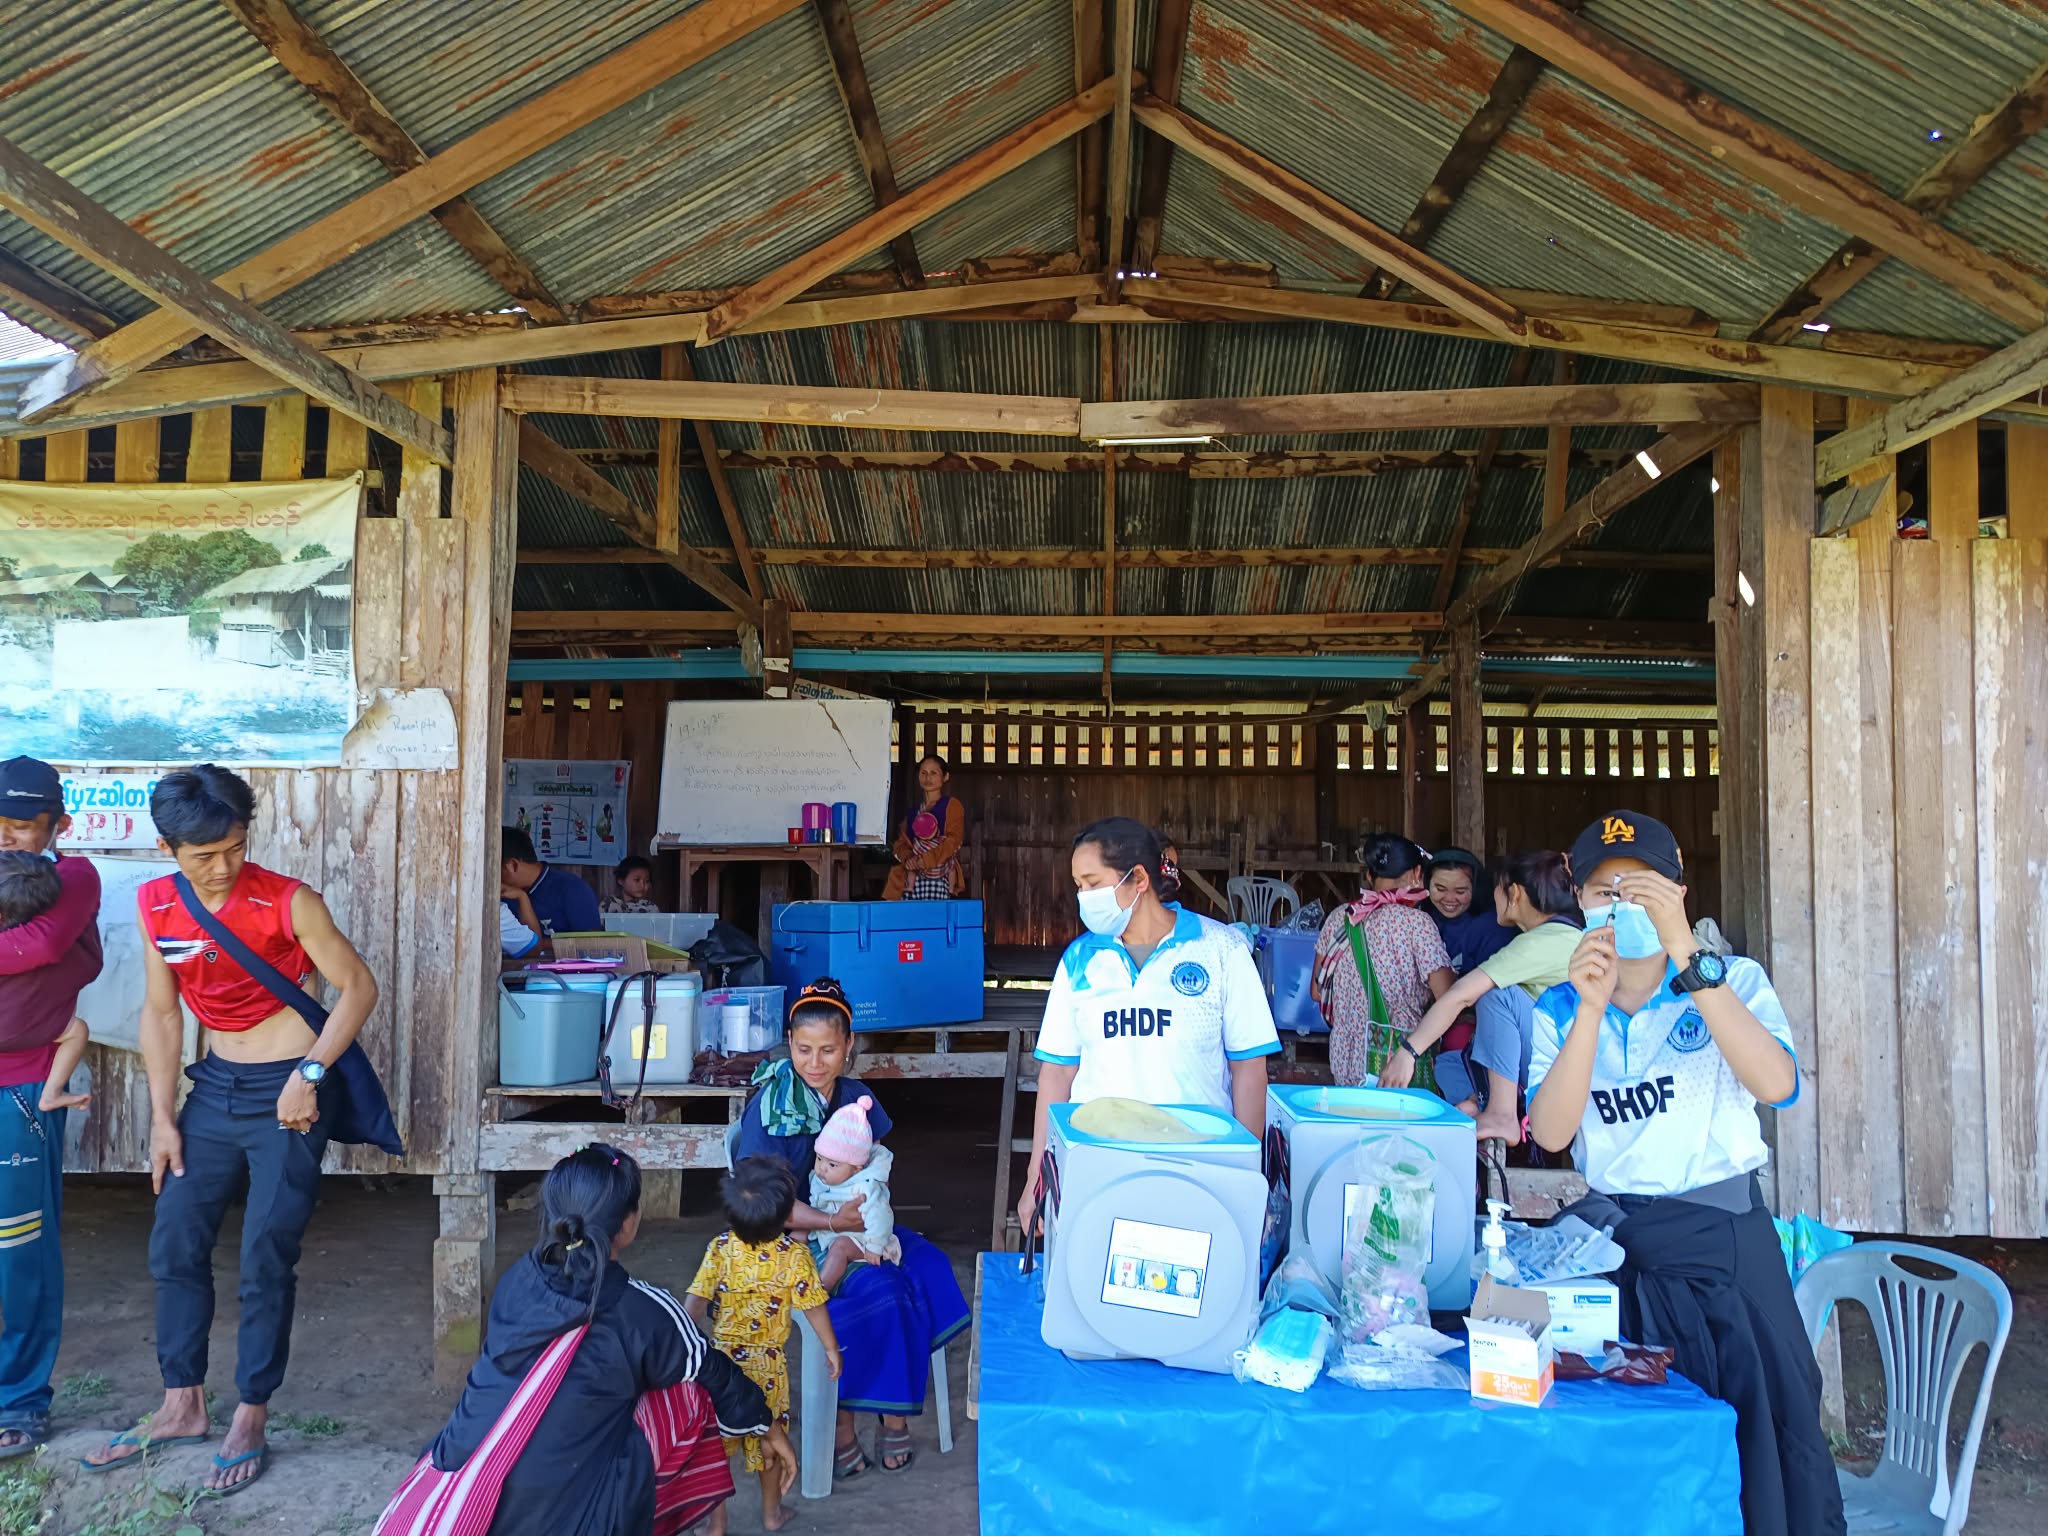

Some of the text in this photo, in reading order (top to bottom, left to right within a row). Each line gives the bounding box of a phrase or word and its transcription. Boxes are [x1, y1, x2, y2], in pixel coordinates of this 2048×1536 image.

[1601, 816, 1635, 845] LA
[855, 1008, 877, 1016] systems
[1103, 1007, 1172, 1039] BHDF
[1591, 1075, 1675, 1125] BHDF
